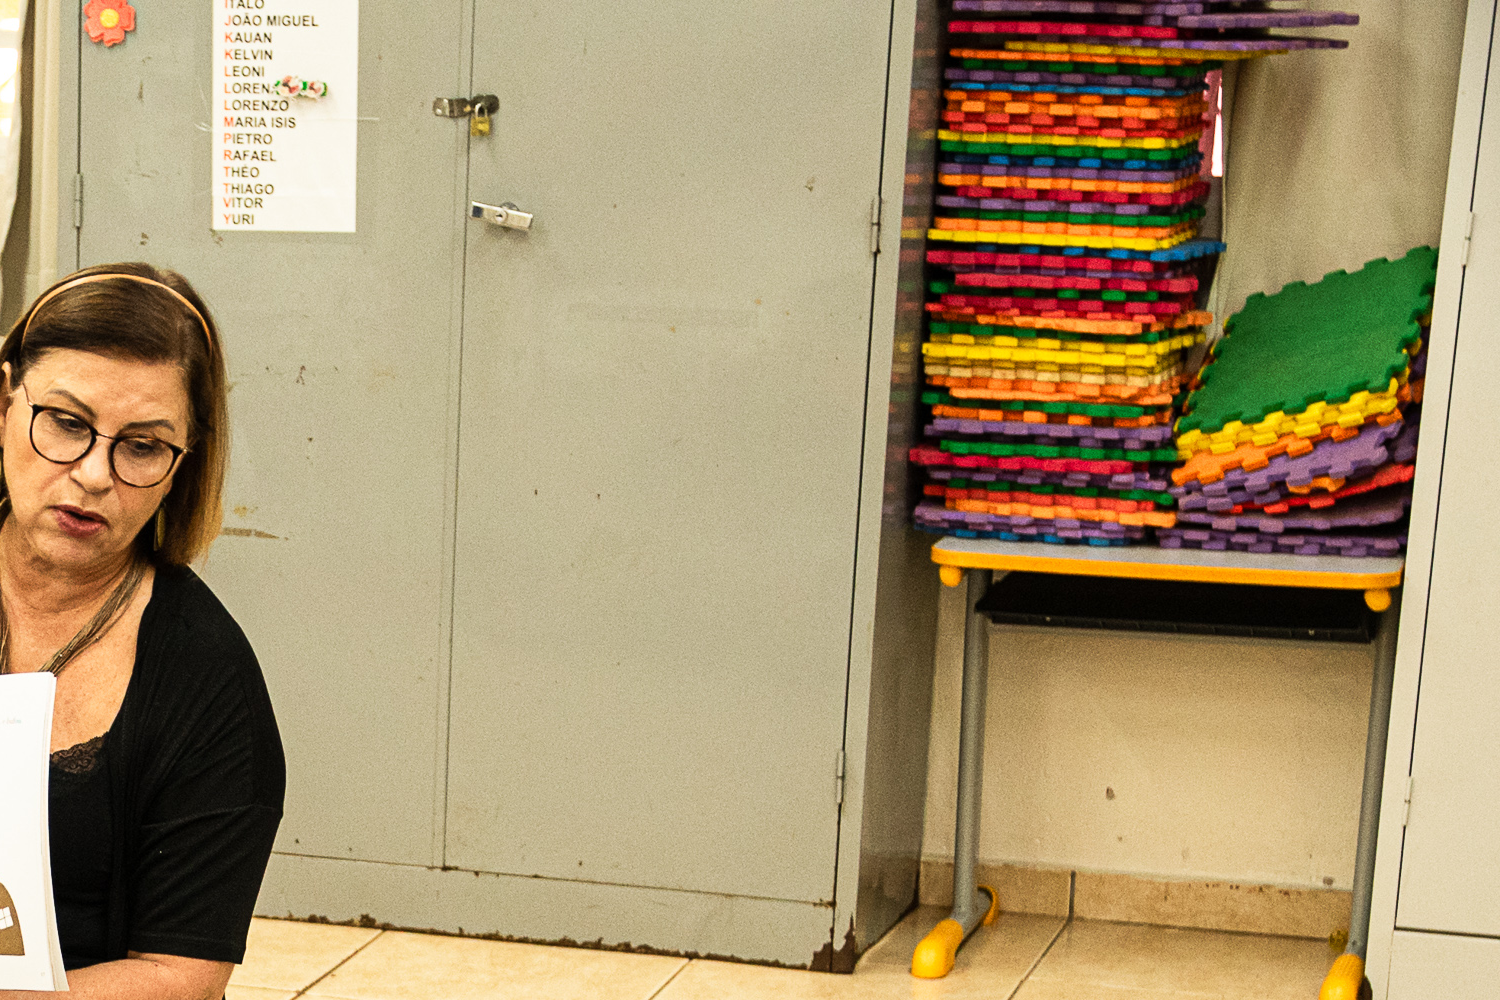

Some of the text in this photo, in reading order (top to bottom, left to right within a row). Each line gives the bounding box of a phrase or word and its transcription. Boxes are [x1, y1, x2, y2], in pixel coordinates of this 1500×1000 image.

[224, 12, 319, 27] JOÃO MIGUEL
[224, 32, 272, 44] KAUAN
[224, 49, 273, 61] KELVIN
[224, 66, 265, 77] LEONI
[224, 82, 274, 94] LOREN
[223, 99, 290, 112] LORENZO
[223, 116, 297, 129] MARIA ISIS
[223, 133, 273, 145] PIETRO
[223, 149, 277, 162] RAFAEL
[223, 183, 275, 195] THIAGO
[223, 197, 264, 209] VITOR
[223, 213, 255, 225] YURI
